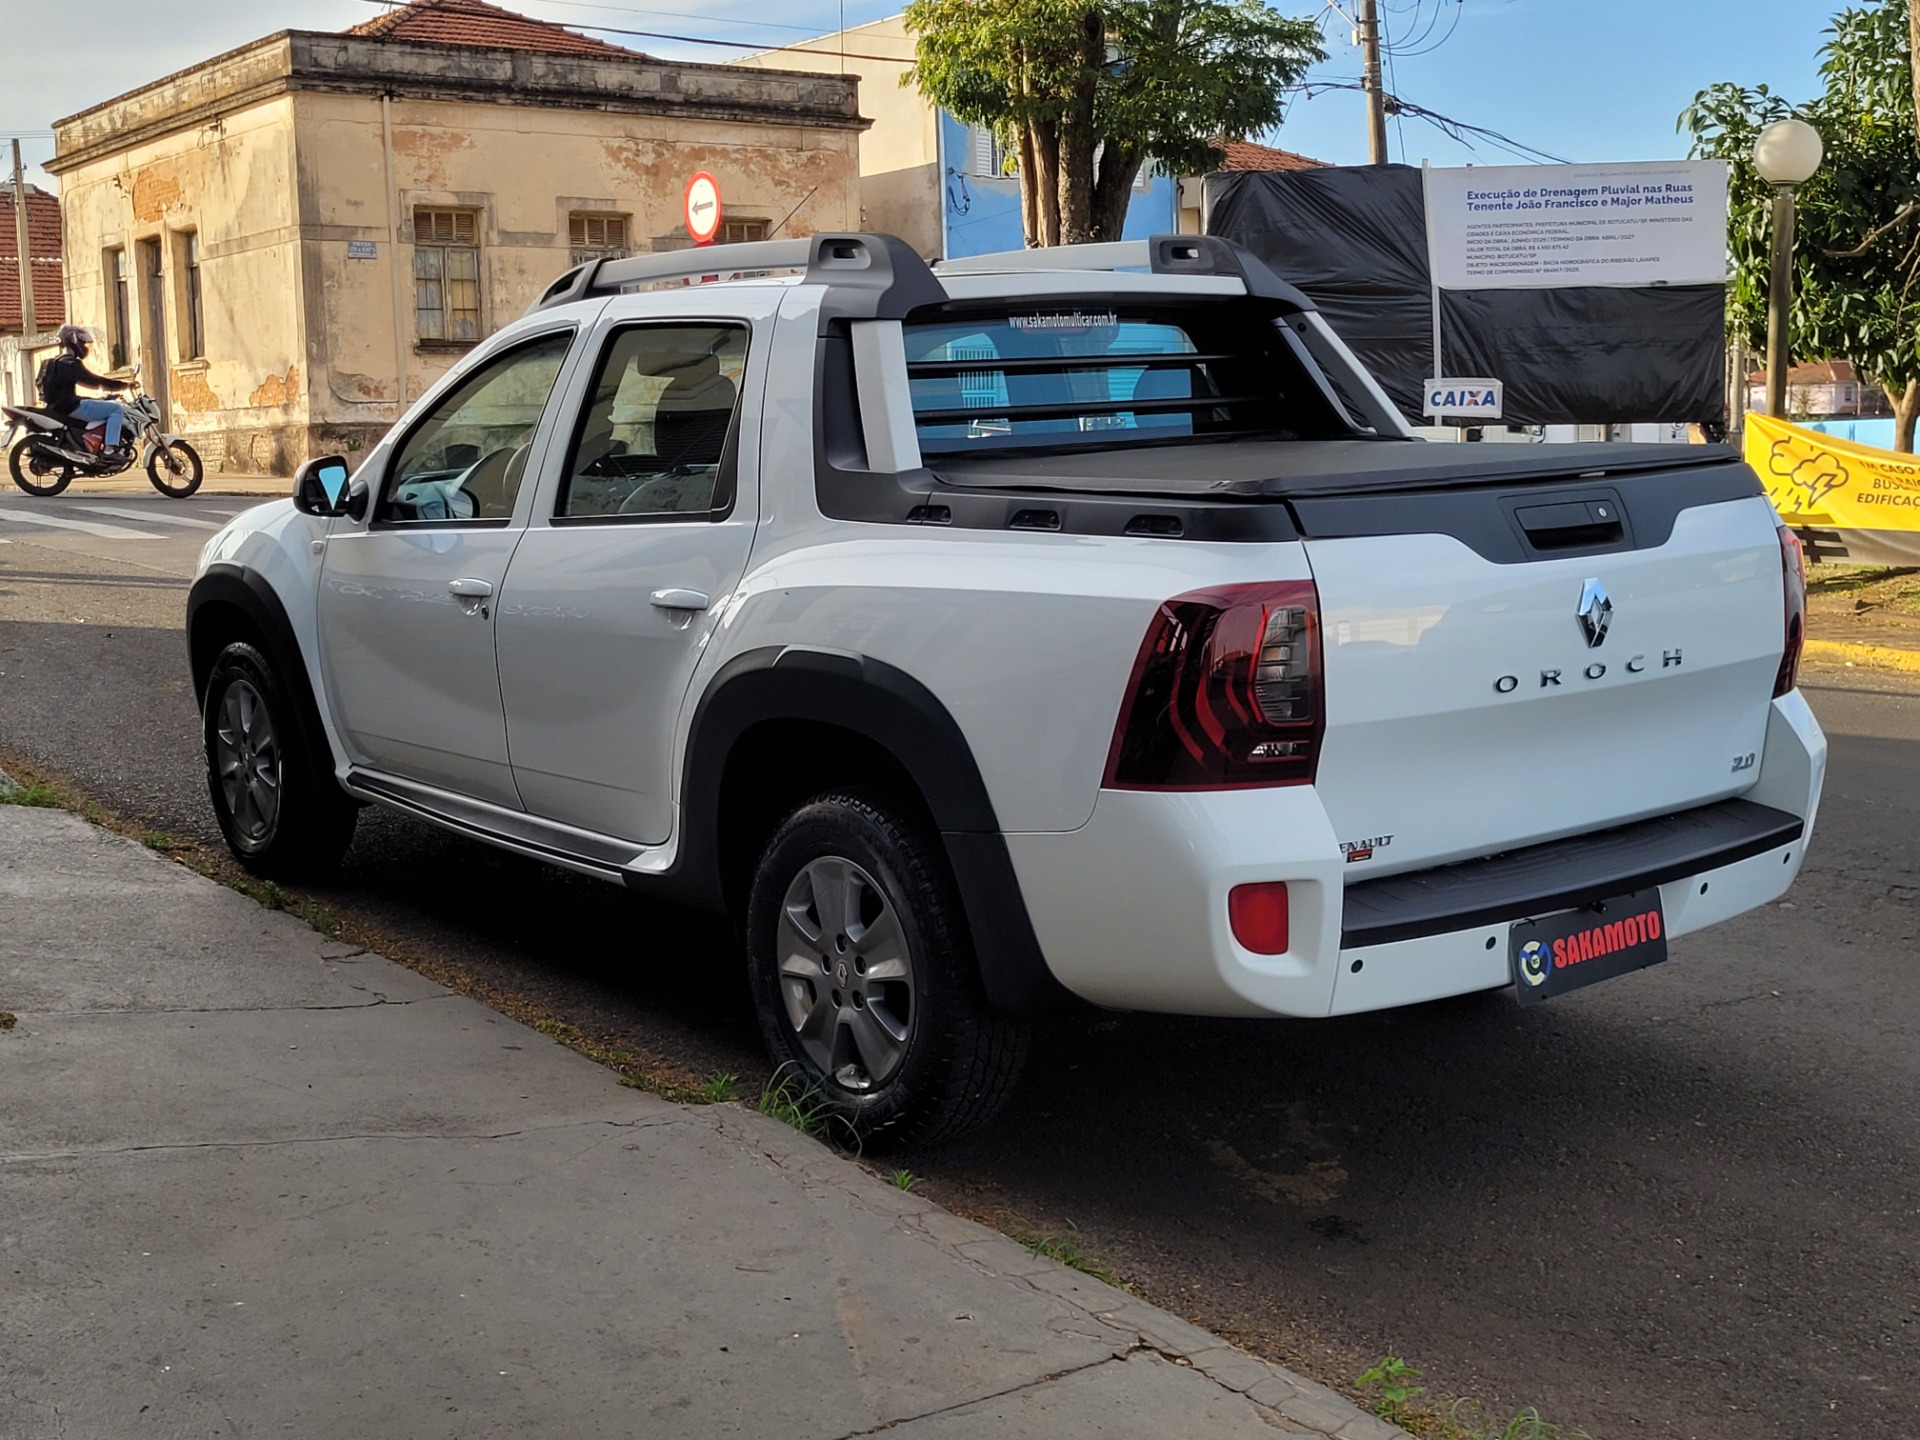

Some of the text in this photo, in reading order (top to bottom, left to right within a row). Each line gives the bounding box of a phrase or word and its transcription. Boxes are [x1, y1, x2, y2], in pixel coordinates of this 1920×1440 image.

[1467, 190, 1520, 200] Execução
[1523, 189, 1537, 198] de
[1540, 188, 1598, 198] Drenagem
[1602, 185, 1640, 194] Pluvial
[1665, 184, 1693, 192] Ruas
[1467, 201, 1513, 211] Tenente
[1515, 200, 1542, 210] João
[1545, 199, 1598, 209] Francisco
[1611, 196, 1643, 207] Major
[1645, 195, 1694, 205] Matheus
[1008, 311, 1117, 328] www.sakamotomulticar.com.br
[1431, 390, 1496, 406] CAIXA
[1880, 464, 1915, 474] CASO
[1493, 648, 1682, 693] OROCH
[1339, 835, 1394, 853] ENAULT
[1553, 911, 1660, 968] SAKAMOTO
